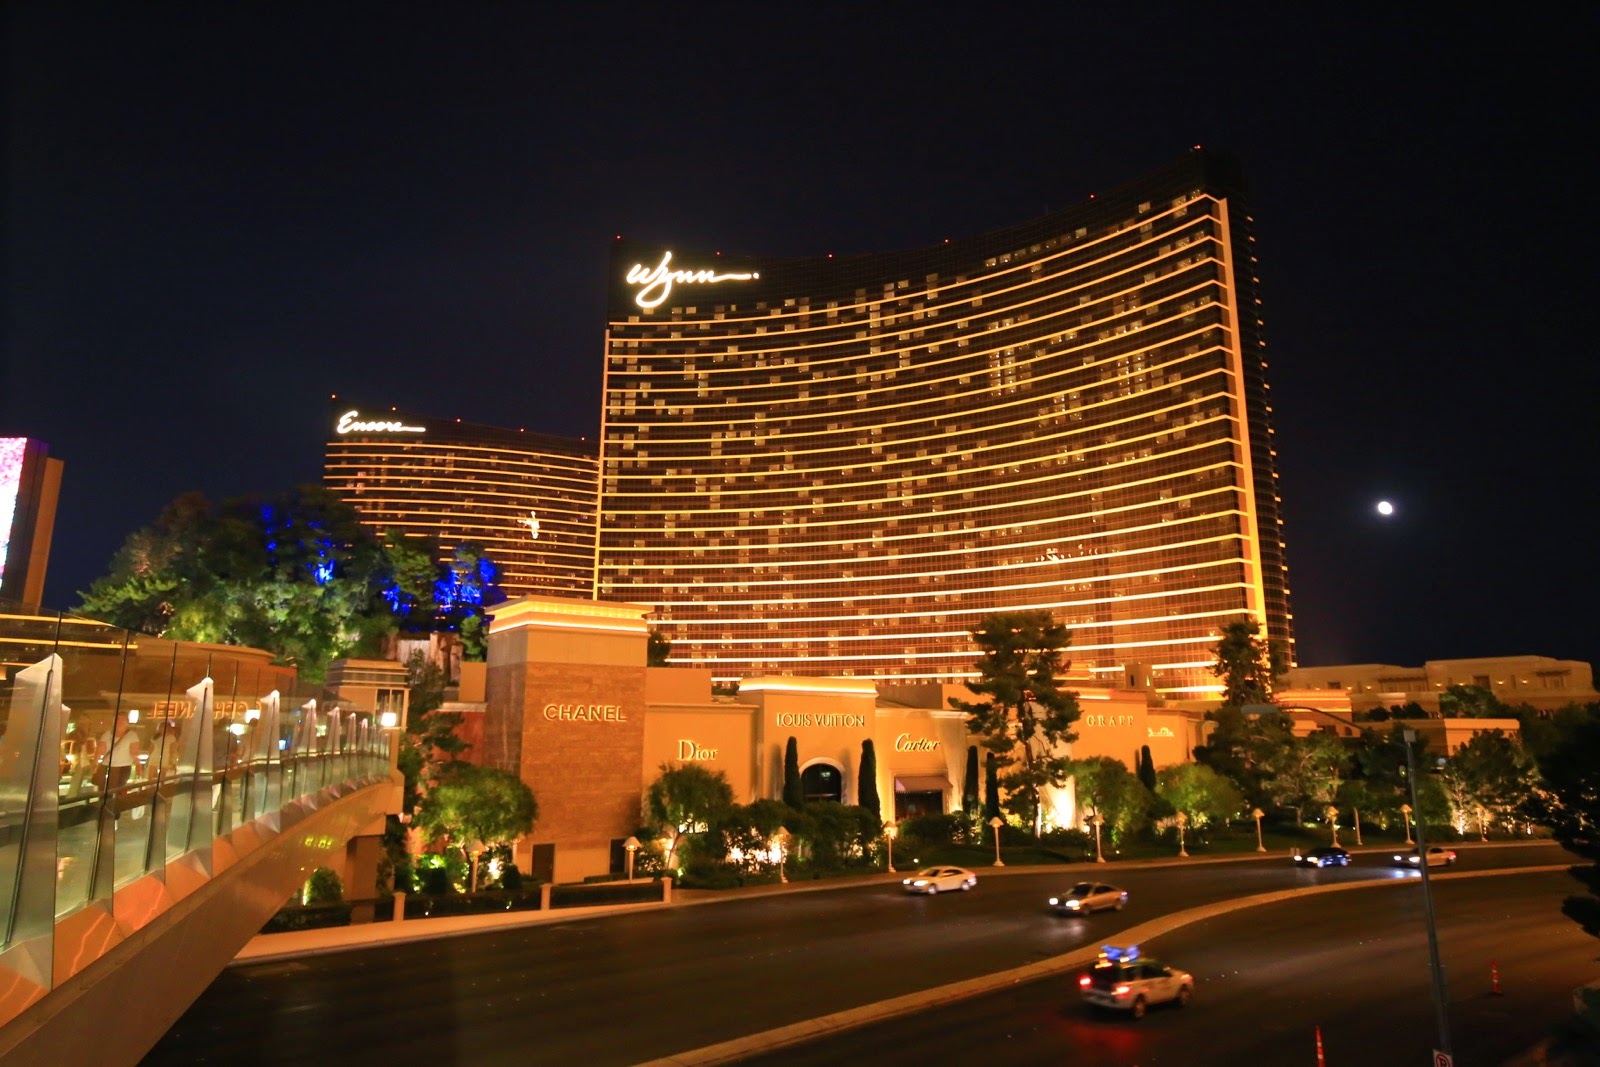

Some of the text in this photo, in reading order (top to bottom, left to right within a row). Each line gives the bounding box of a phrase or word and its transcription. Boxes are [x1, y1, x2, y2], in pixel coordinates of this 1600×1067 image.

[337, 410, 426, 434] Encore
[543, 703, 627, 722] CHANEL
[776, 713, 865, 728] LOUIS VUITTON
[1086, 714, 1134, 727] GRAFF
[677, 739, 718, 761] Dior
[895, 733, 941, 752] Cartier
